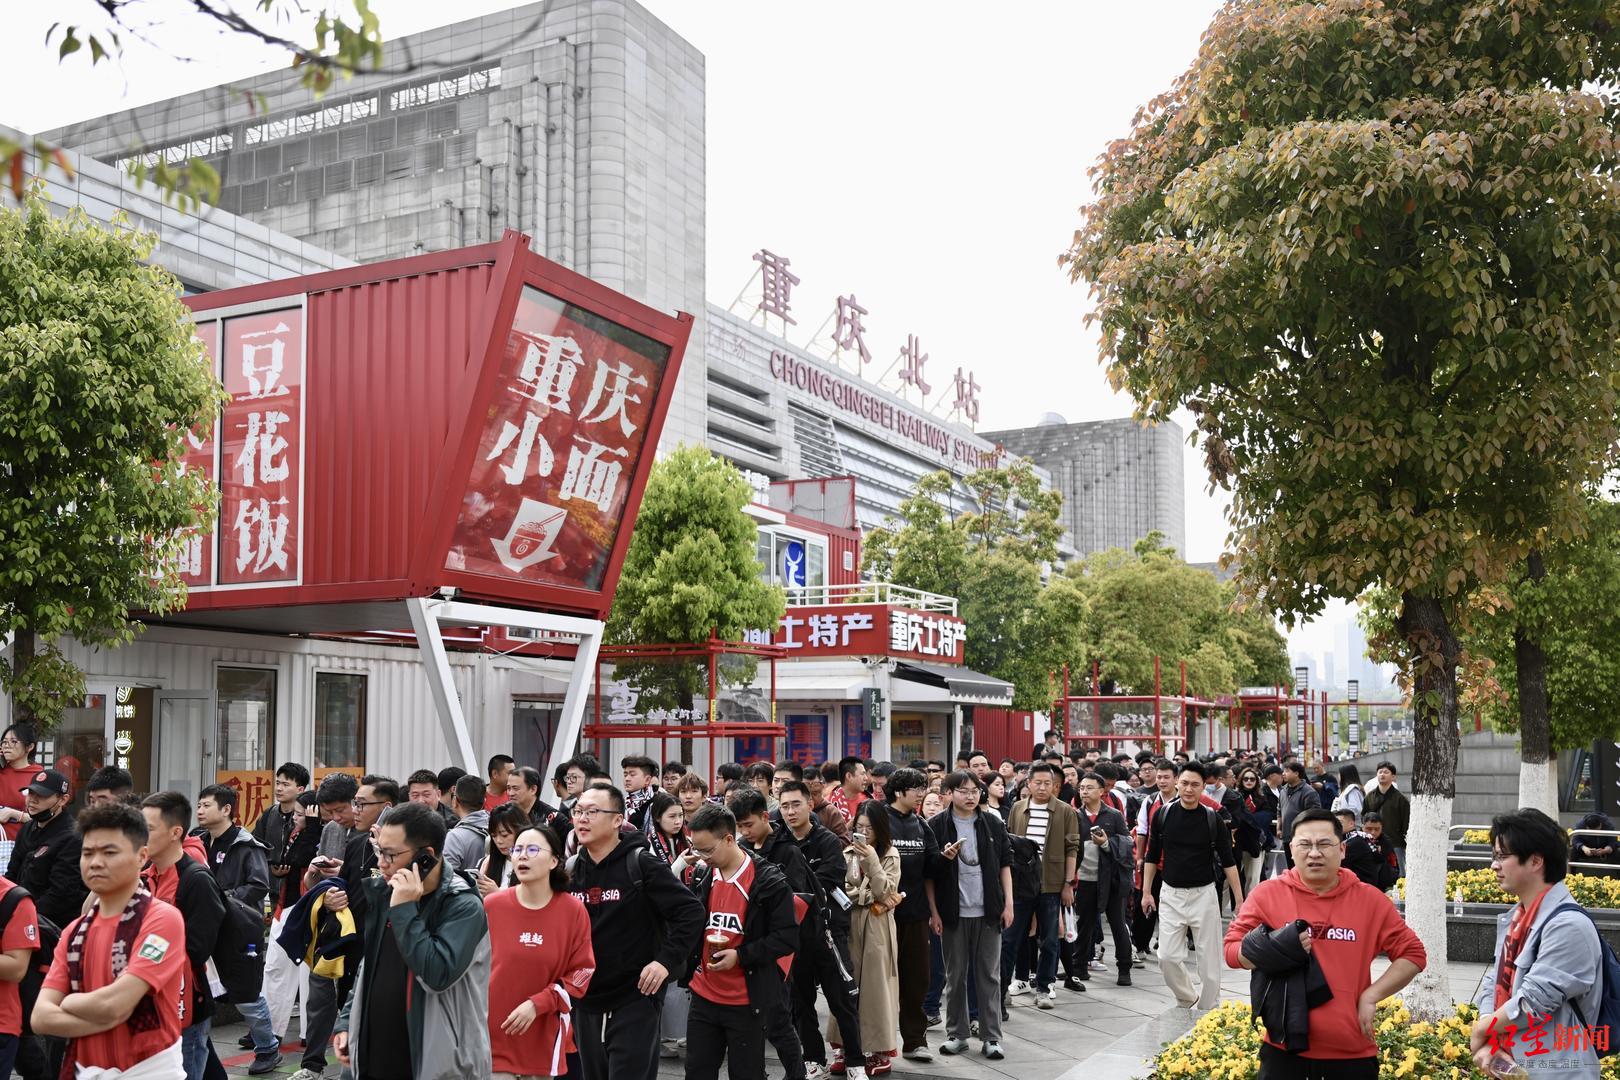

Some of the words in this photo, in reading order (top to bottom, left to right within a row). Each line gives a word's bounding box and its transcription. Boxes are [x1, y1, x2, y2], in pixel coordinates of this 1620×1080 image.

[507, 330, 648, 439] 重庆
[752, 248, 982, 423] 重庆北站
[233, 321, 291, 574] 豆花饭
[770, 349, 893, 437] CHONGQINGBEI
[897, 410, 950, 456] RAILWAY
[486, 411, 629, 513] 小面
[890, 610, 967, 657] 重庆土特产
[1326, 927, 1356, 941] ASIA
